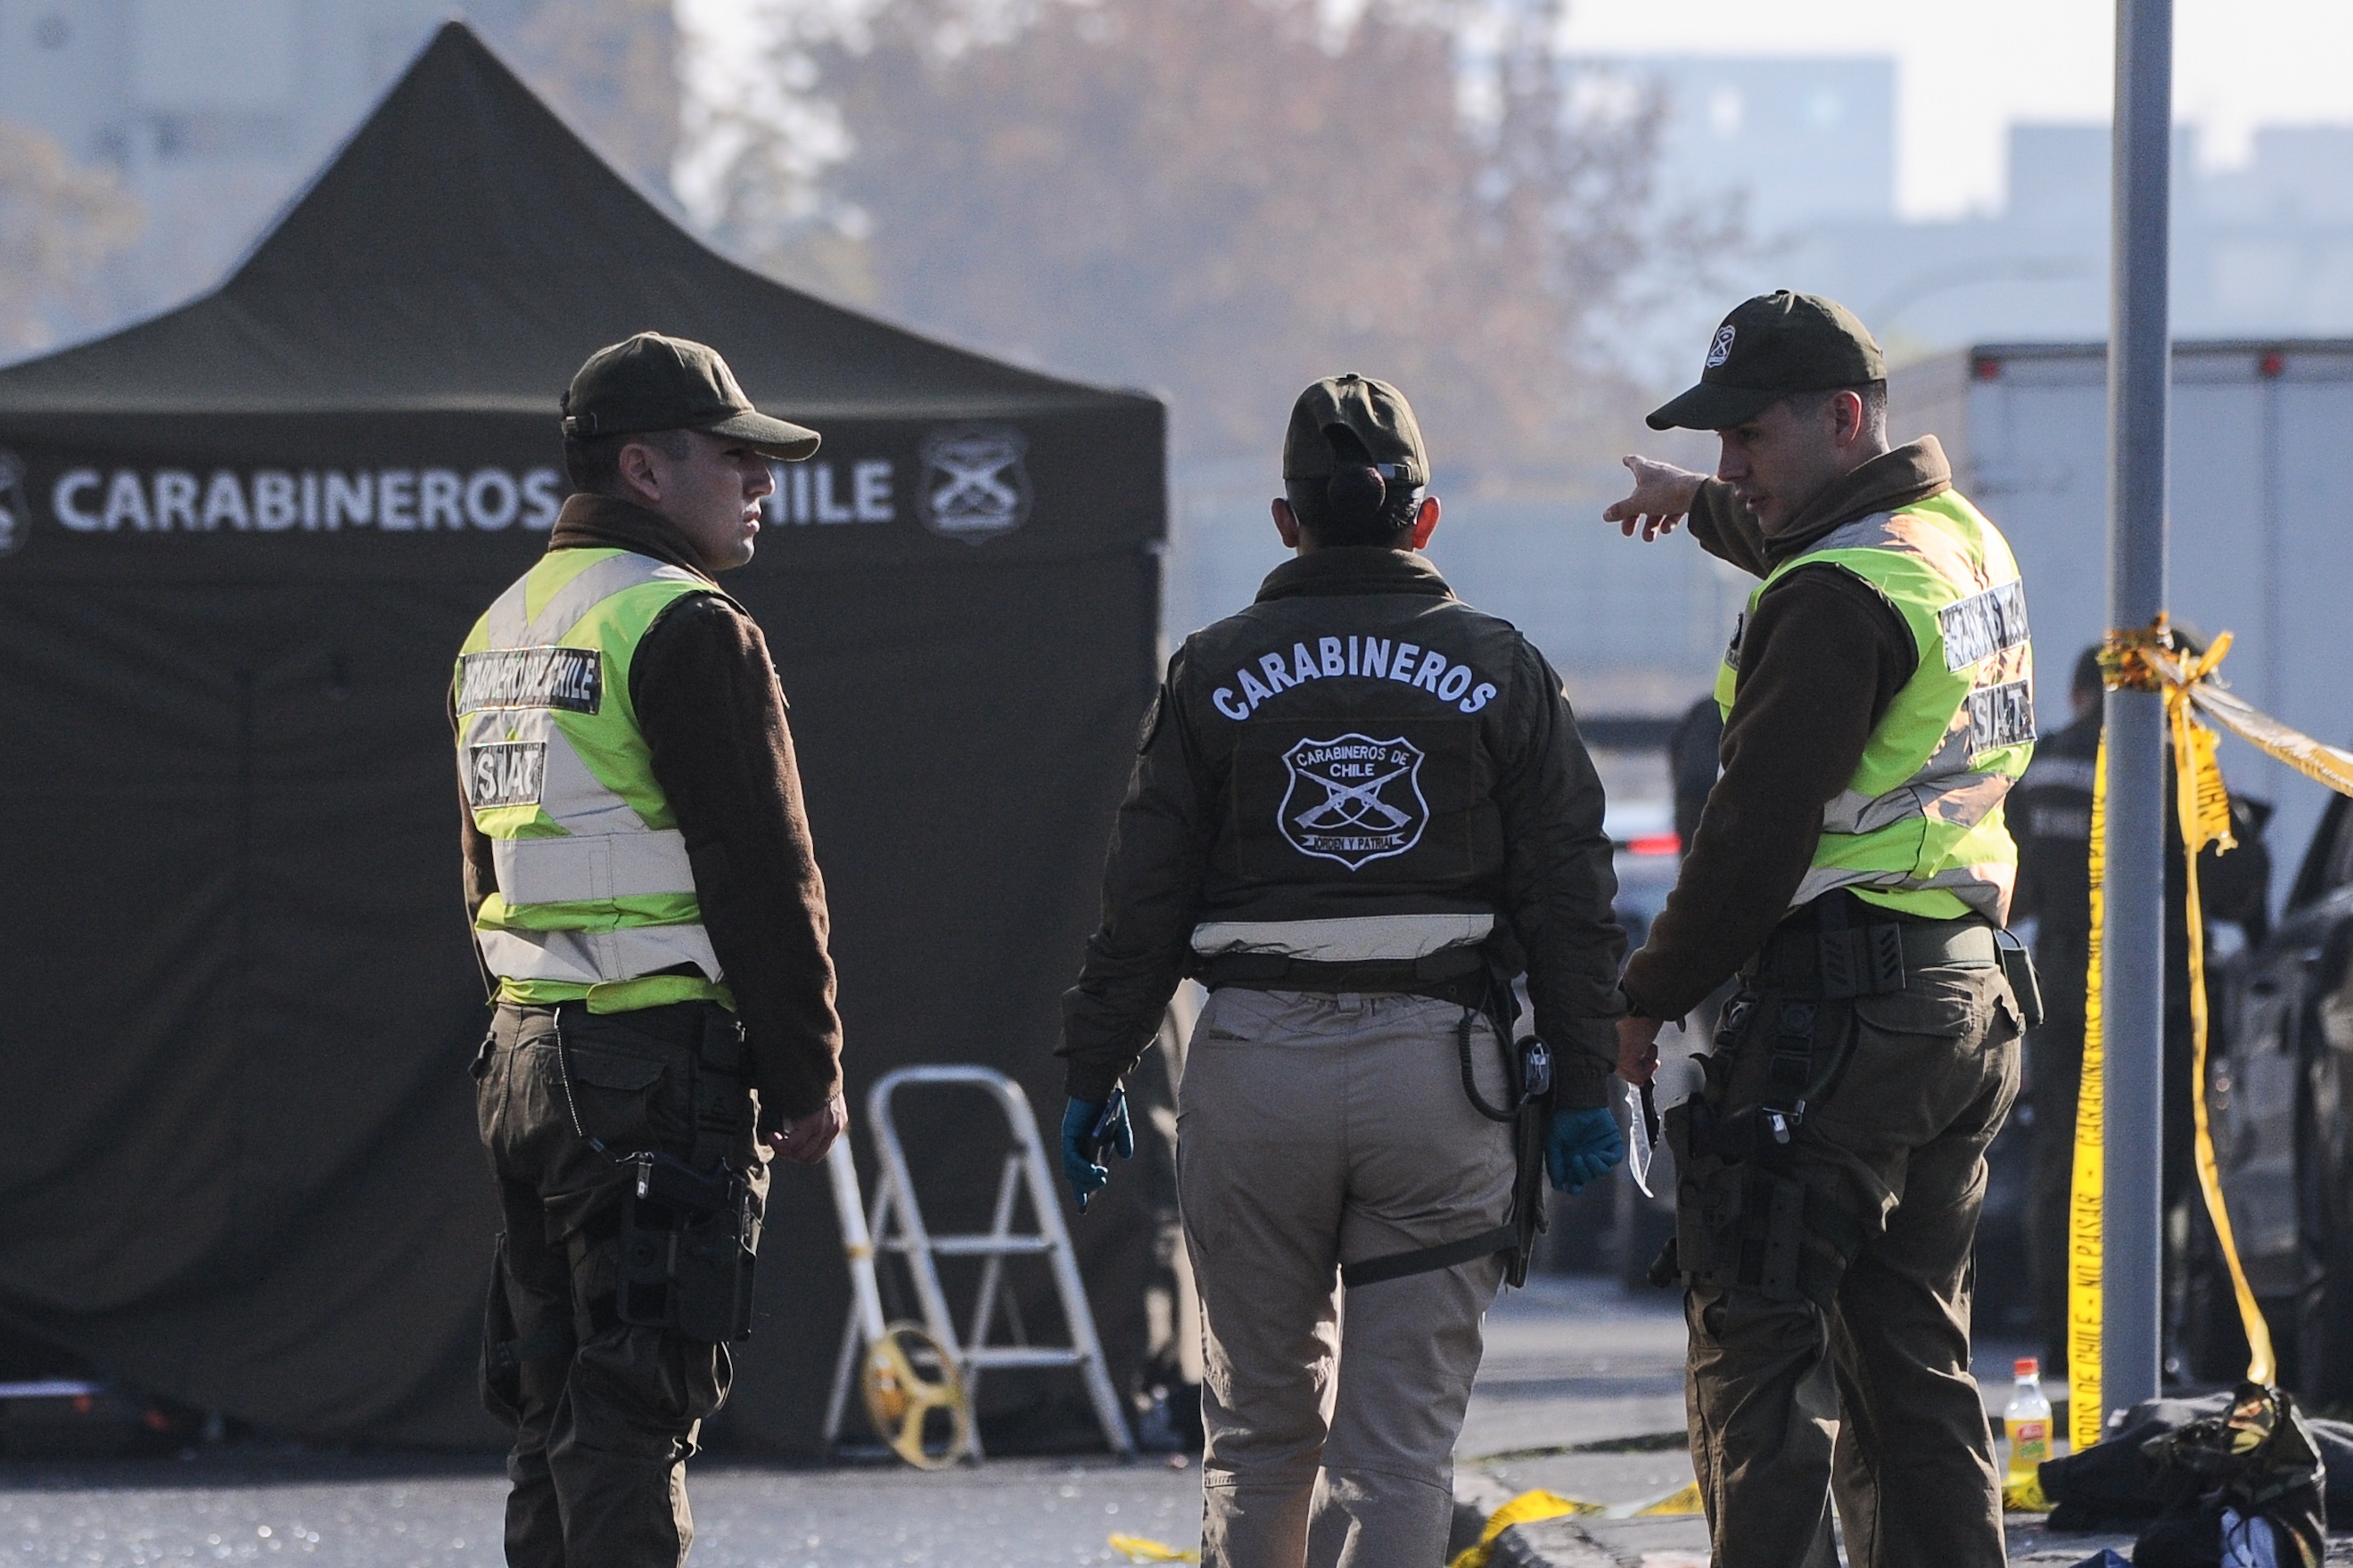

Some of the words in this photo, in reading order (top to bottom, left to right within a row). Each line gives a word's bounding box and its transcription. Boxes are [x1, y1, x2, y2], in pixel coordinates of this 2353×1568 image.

[52, 469, 562, 533] CARABINEROS
[761, 461, 894, 524] HILE
[1213, 636, 1497, 721] CARABINEROS
[1296, 745, 1386, 767] CARABINEROS
[1391, 750, 1410, 766] DE
[1329, 763, 1375, 777] CHILE
[1347, 836, 1355, 850] Y
[2075, 1194, 2102, 1258] PASAR
